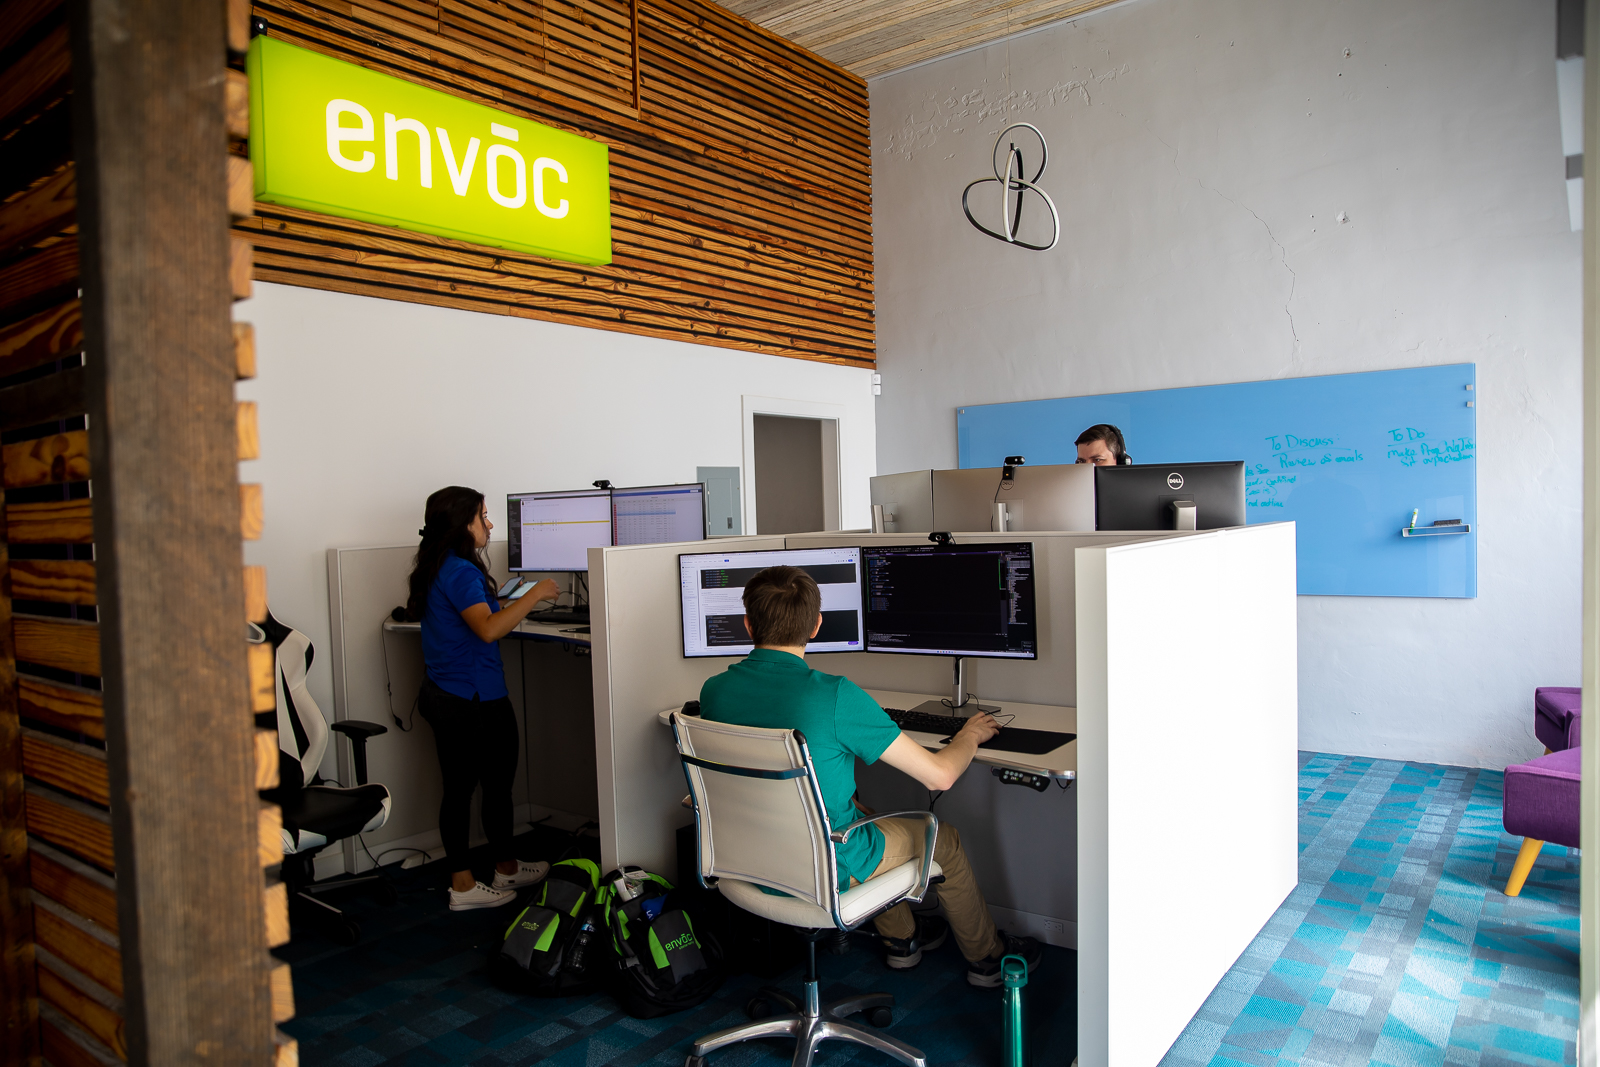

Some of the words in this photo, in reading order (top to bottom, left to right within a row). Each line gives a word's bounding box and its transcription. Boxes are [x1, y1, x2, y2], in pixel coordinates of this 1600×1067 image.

[326, 98, 570, 220] envōc
[1265, 435, 1282, 451] To
[1386, 428, 1404, 442] To
